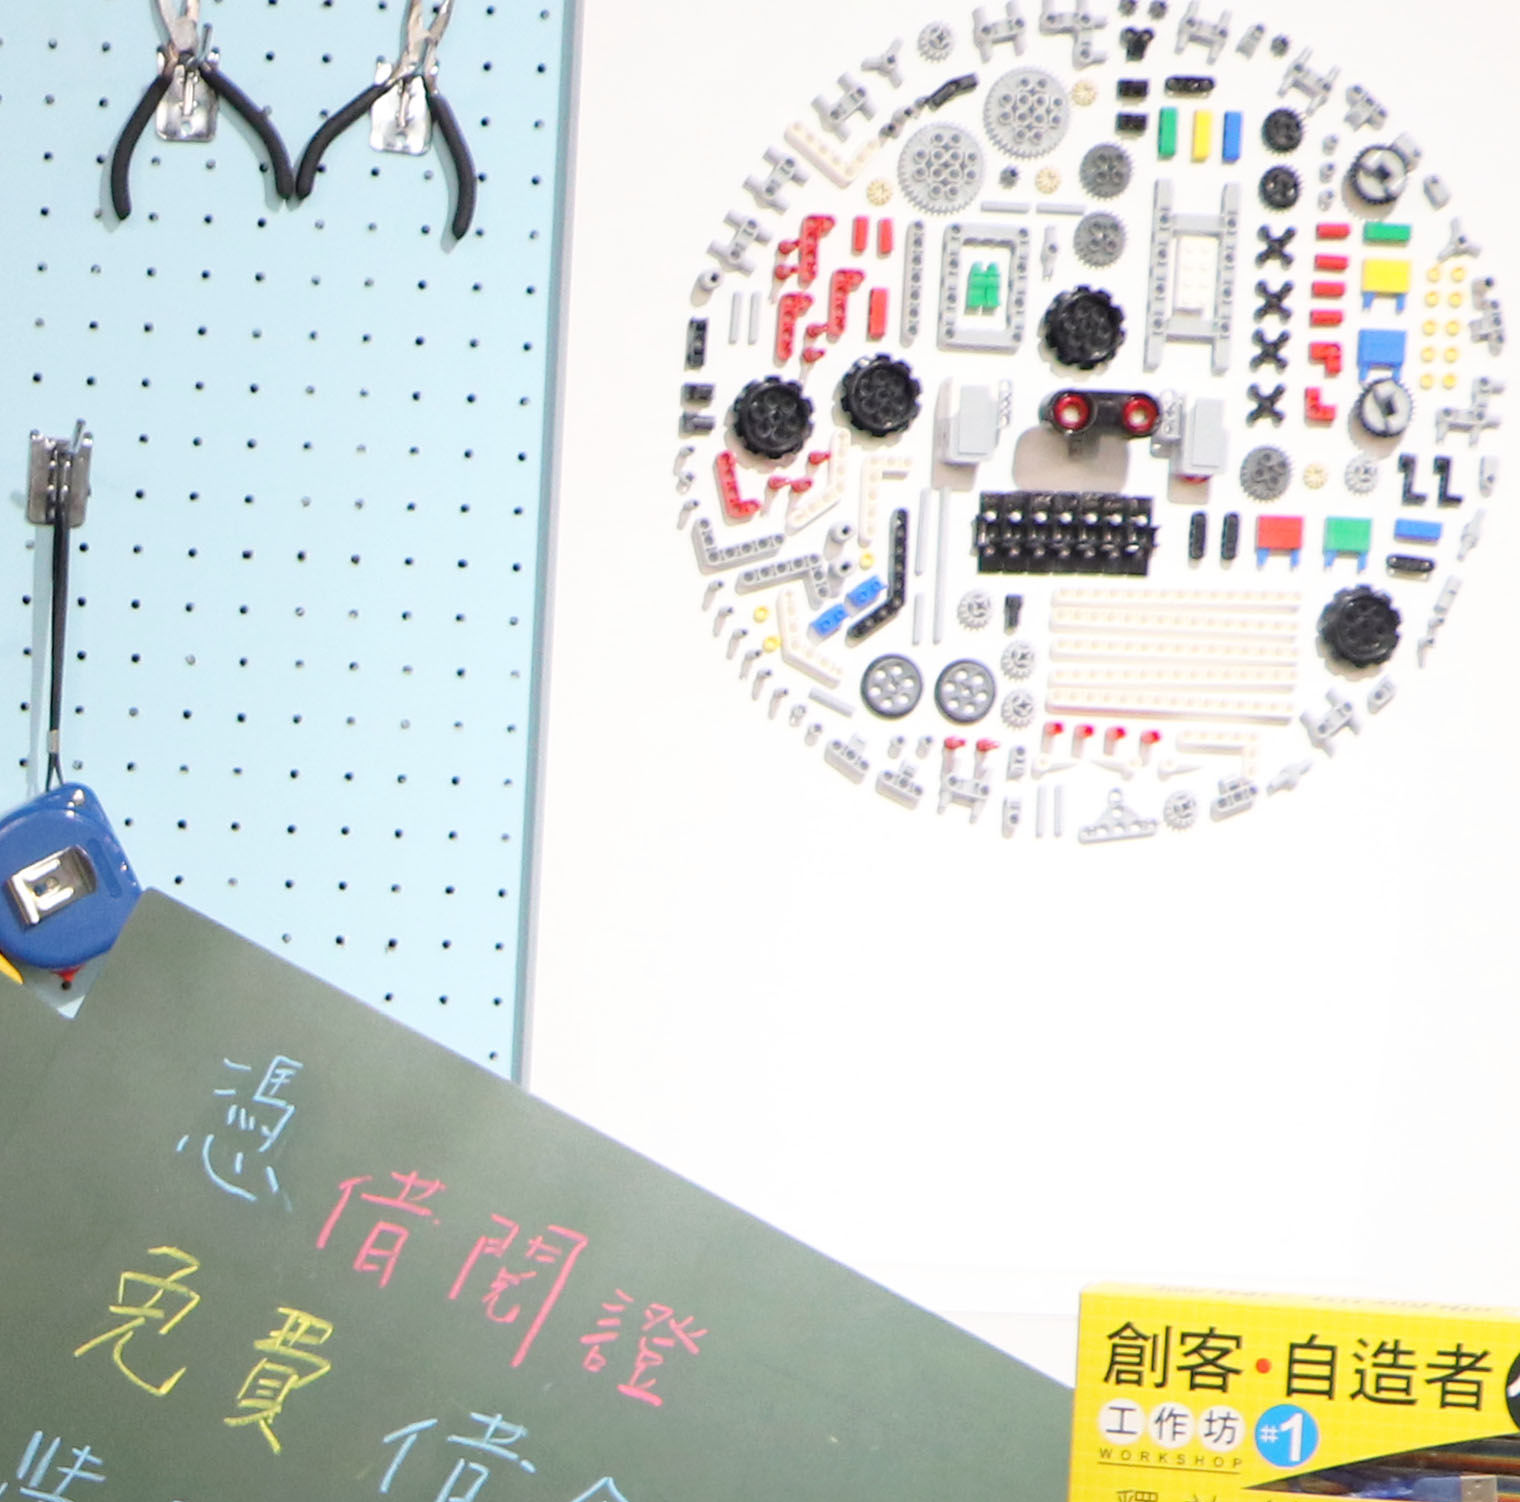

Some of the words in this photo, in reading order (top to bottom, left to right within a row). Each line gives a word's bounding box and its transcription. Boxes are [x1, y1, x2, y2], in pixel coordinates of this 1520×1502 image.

[1107, 1404, 1241, 1449] 工作坊
[1259, 1411, 1305, 1463] #1
[1099, 1447, 1244, 1469] WORKSHOP
